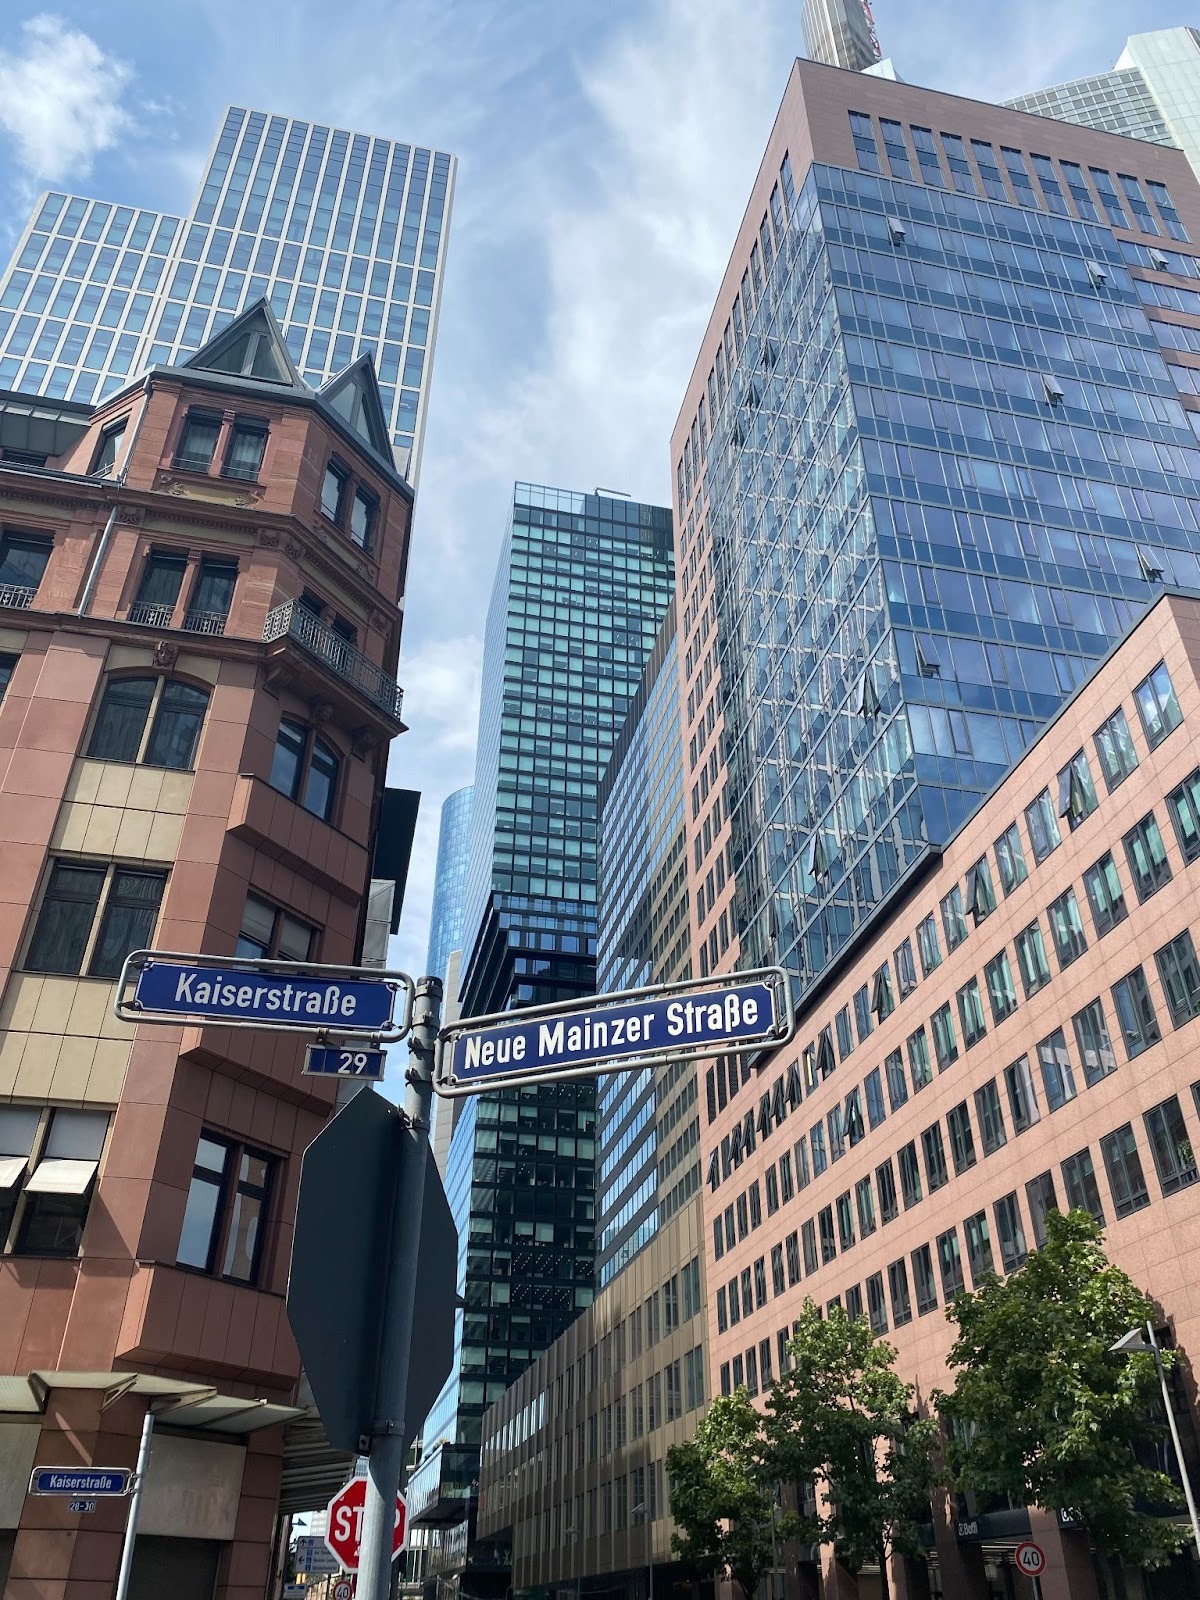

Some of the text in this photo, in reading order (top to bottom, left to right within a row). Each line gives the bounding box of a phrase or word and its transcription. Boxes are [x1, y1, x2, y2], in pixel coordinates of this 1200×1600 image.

[174, 972, 357, 1017] Kaiserstraße
[464, 993, 759, 1070] Neue Mainzer Straße
[337, 1052, 368, 1075] 29
[49, 1475, 112, 1489] Kaiserstraße
[1022, 1551, 1040, 1567] 40
[336, 1587, 349, 1599] 40
